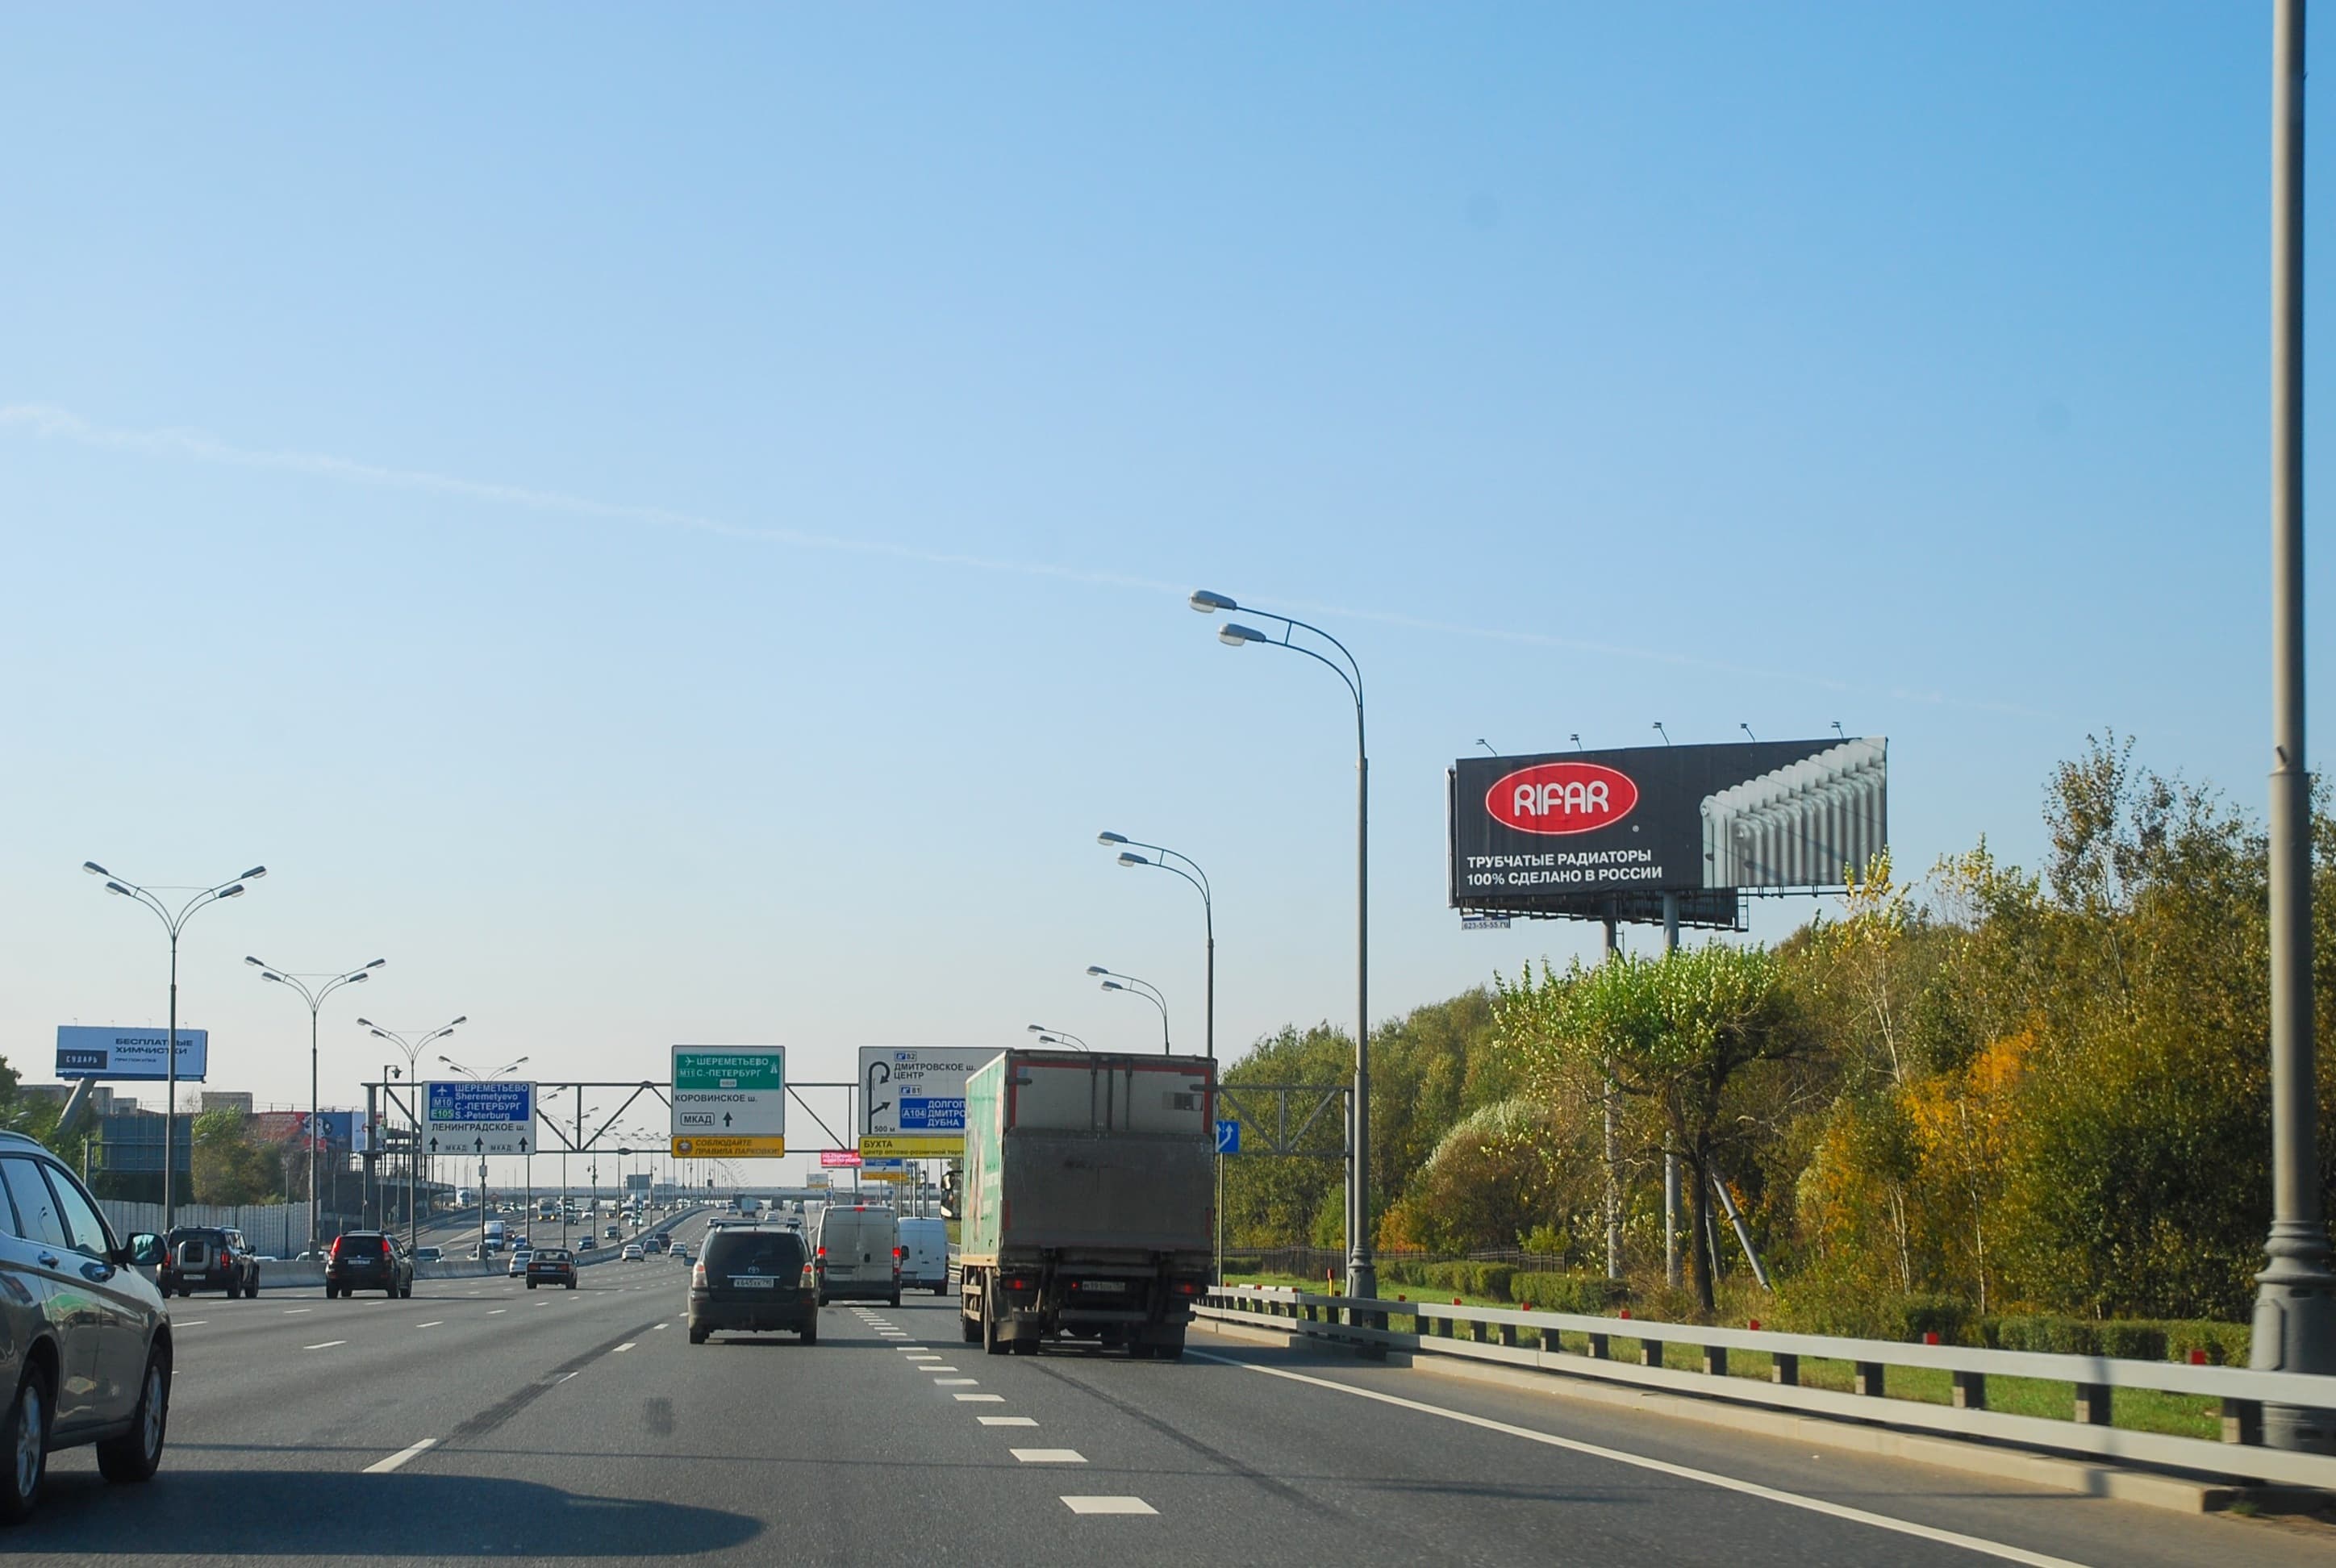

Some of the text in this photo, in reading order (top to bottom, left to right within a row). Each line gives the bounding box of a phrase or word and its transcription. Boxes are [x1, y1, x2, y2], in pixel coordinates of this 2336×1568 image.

[1514, 781, 1609, 816] RIFAR
[1467, 849, 1651, 869] ТРУБЧАТЫЕ РАДИАТОРЫ
[1466, 866, 1662, 886] 100% СДЕЛАНО В РОССИИ
[894, 1063, 964, 1072] ДМИТРОВСКОЕ
[696, 1069, 761, 1078] С.-ПЕТЕРБУРГ
[894, 1071, 924, 1080] ЦЕНТР
[455, 1084, 528, 1092] ШЕРЕМЕТЬЕВО
[455, 1093, 518, 1102] Sheremetyevo
[674, 1094, 746, 1103] КОРОВИНСКОЕ
[455, 1103, 521, 1111] С.-ПЕТЕРБУРГ
[455, 1111, 511, 1120] S.-Peterburg
[683, 1116, 712, 1125] МКАД
[927, 1118, 960, 1127] ДУБНА
[432, 1123, 514, 1132] ЛЕНИНГРАДСКОЕ
[864, 1141, 893, 1149] БУХТА
